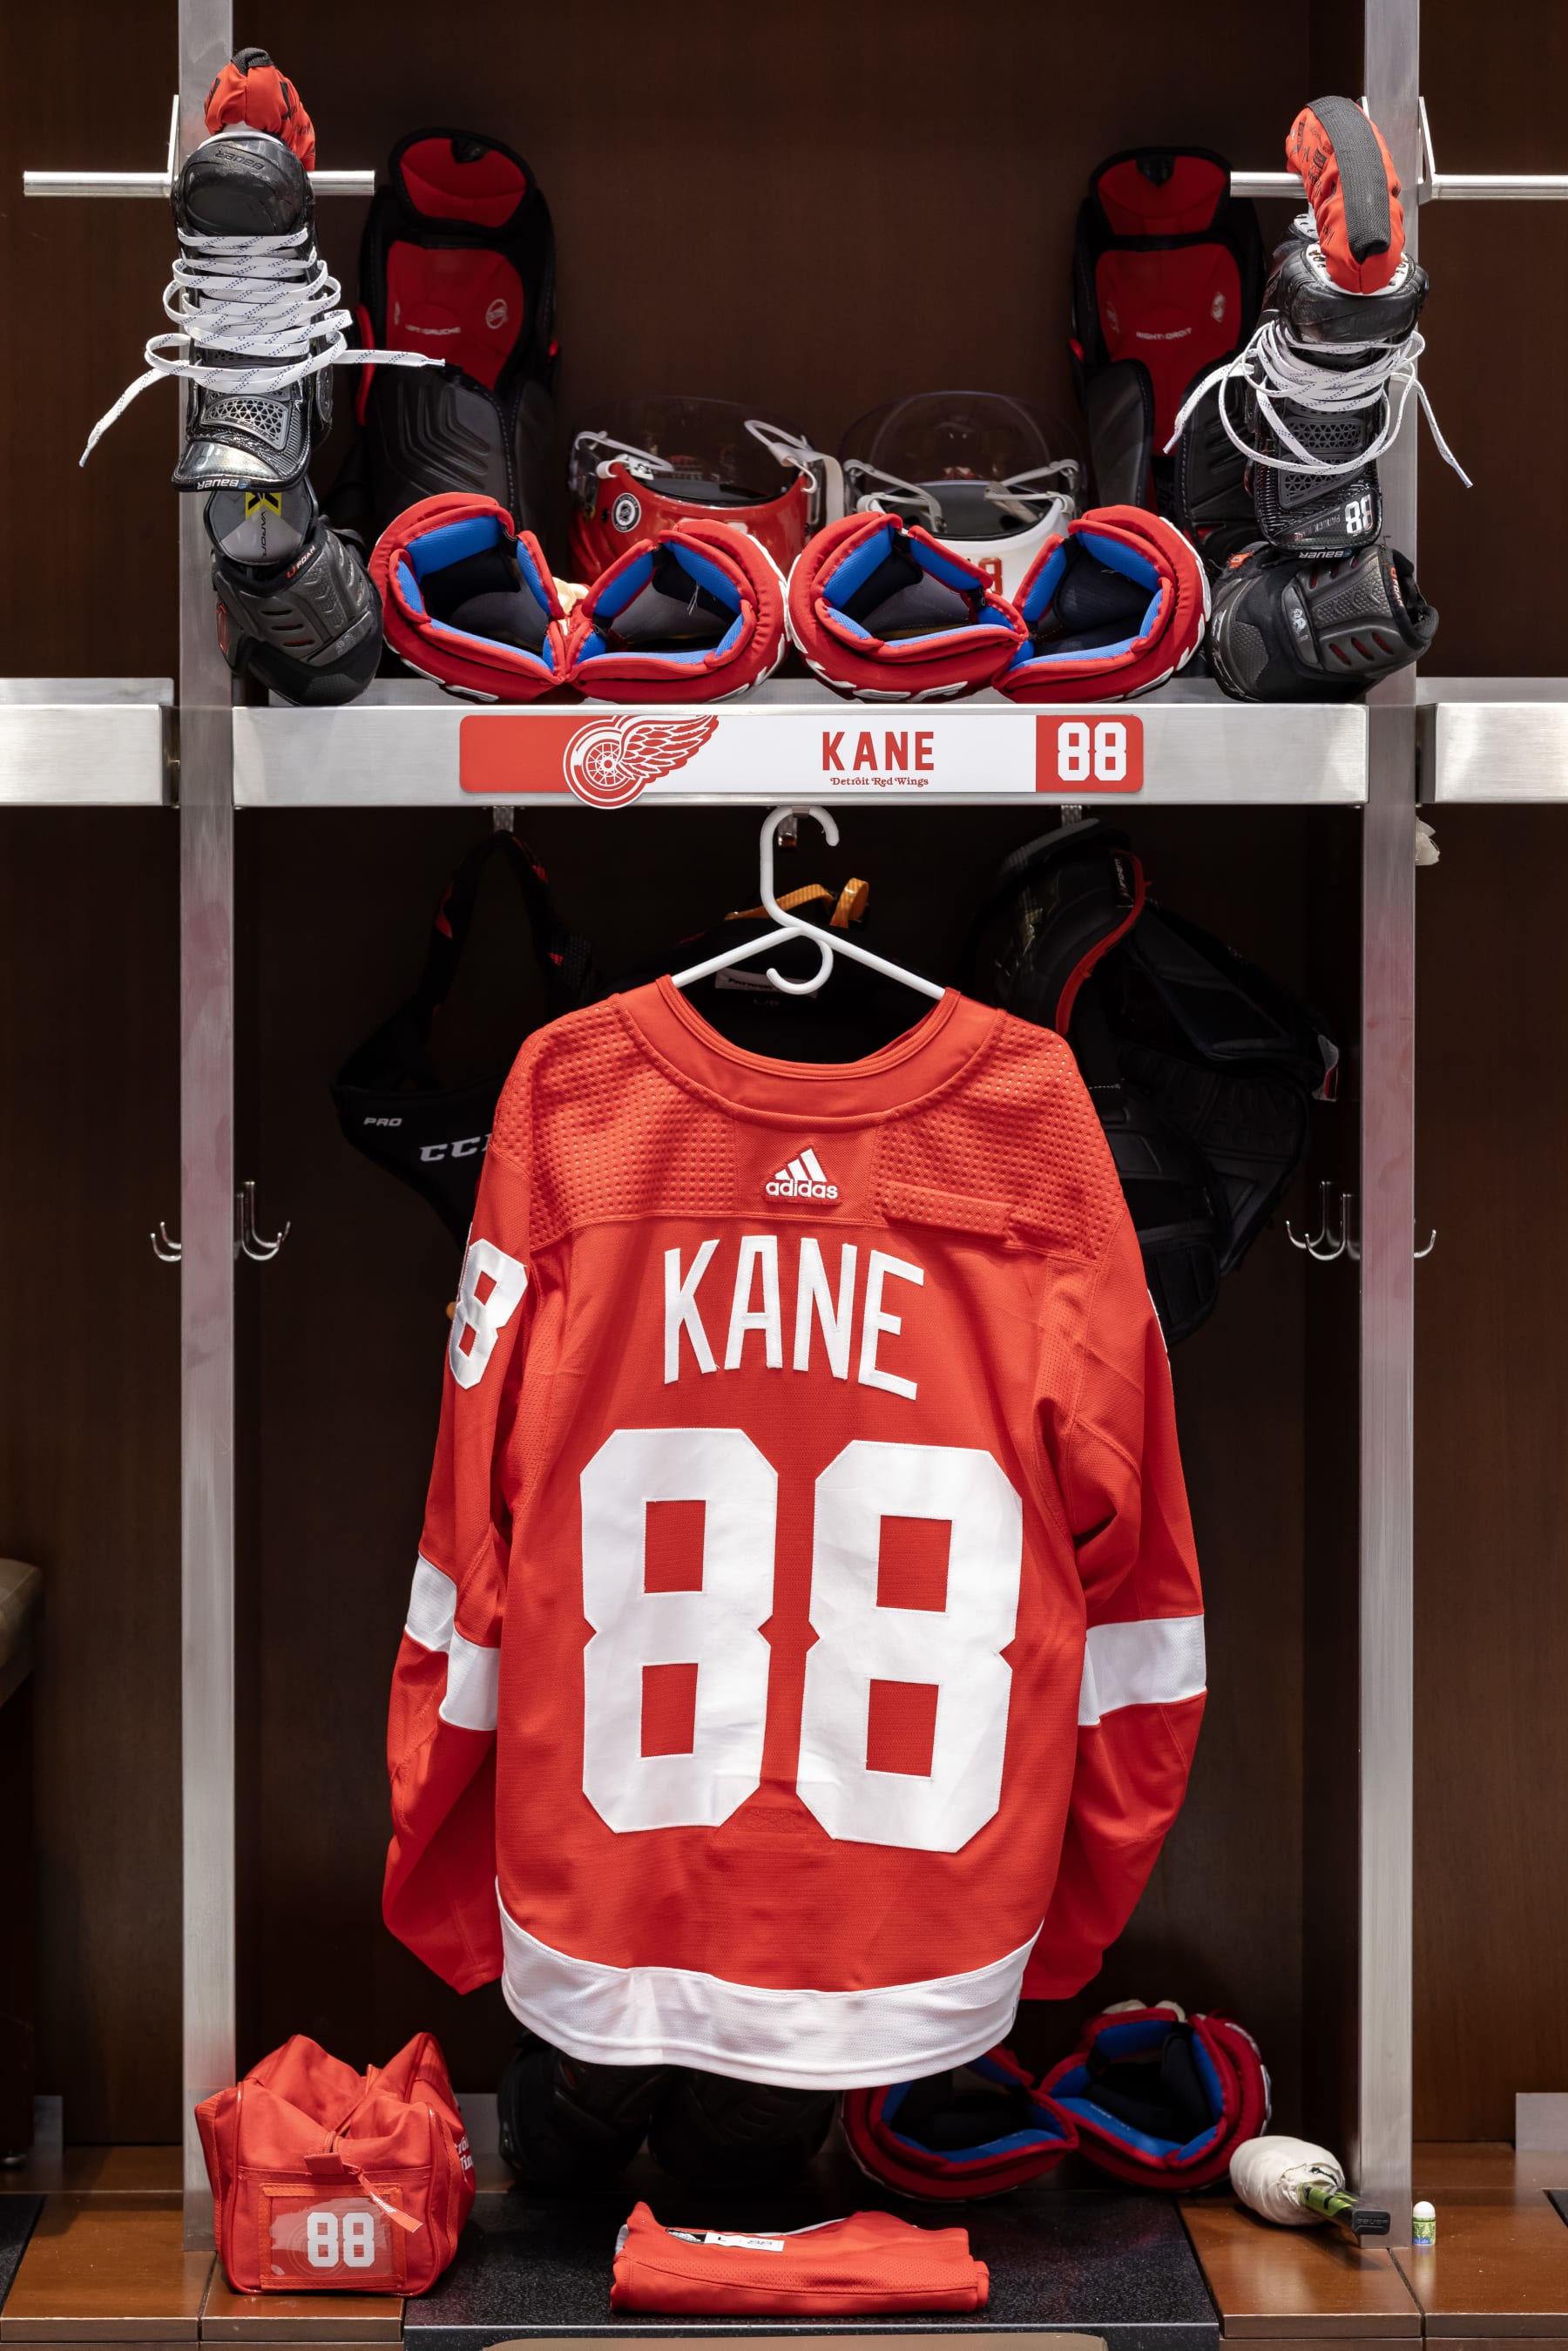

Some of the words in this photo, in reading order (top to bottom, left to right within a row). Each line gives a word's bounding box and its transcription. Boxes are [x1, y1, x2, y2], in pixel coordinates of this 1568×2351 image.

[197, 479, 239, 490] BAUER
[1299, 551, 1344, 559] BAUER
[822, 732, 934, 771] KANE
[1058, 722, 1127, 780] 88
[830, 777, 869, 786] Detroit
[871, 777, 894, 787] Red
[895, 777, 929, 787] Wings
[363, 1118, 402, 1126] PRO
[419, 1133, 494, 1162] CC
[766, 1179, 838, 1199] adidas
[664, 1234, 925, 1401] KANE
[580, 1428, 1023, 1854] 88
[307, 2212, 375, 2267] 88
